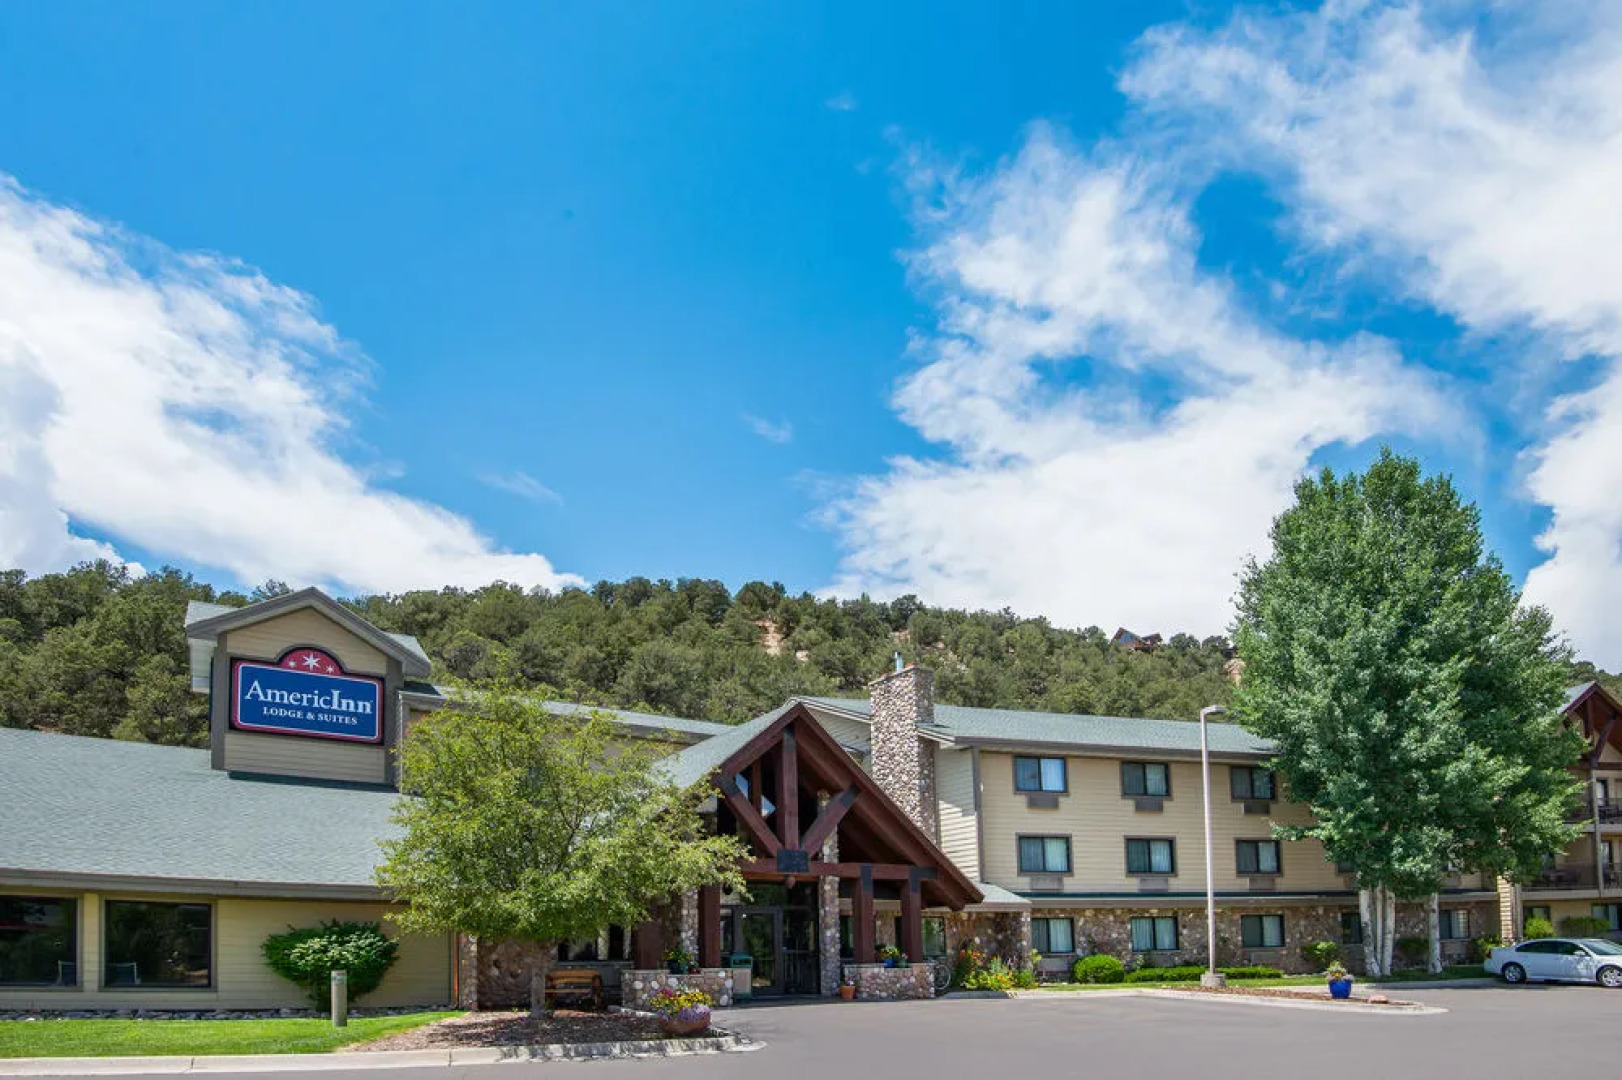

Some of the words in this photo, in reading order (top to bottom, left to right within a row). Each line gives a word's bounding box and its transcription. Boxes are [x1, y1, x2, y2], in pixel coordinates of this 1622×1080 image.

[245, 680, 372, 714] AmericInn
[263, 706, 304, 719] LODGE
[306, 711, 315, 721] &
[317, 712, 358, 725] SUITES
